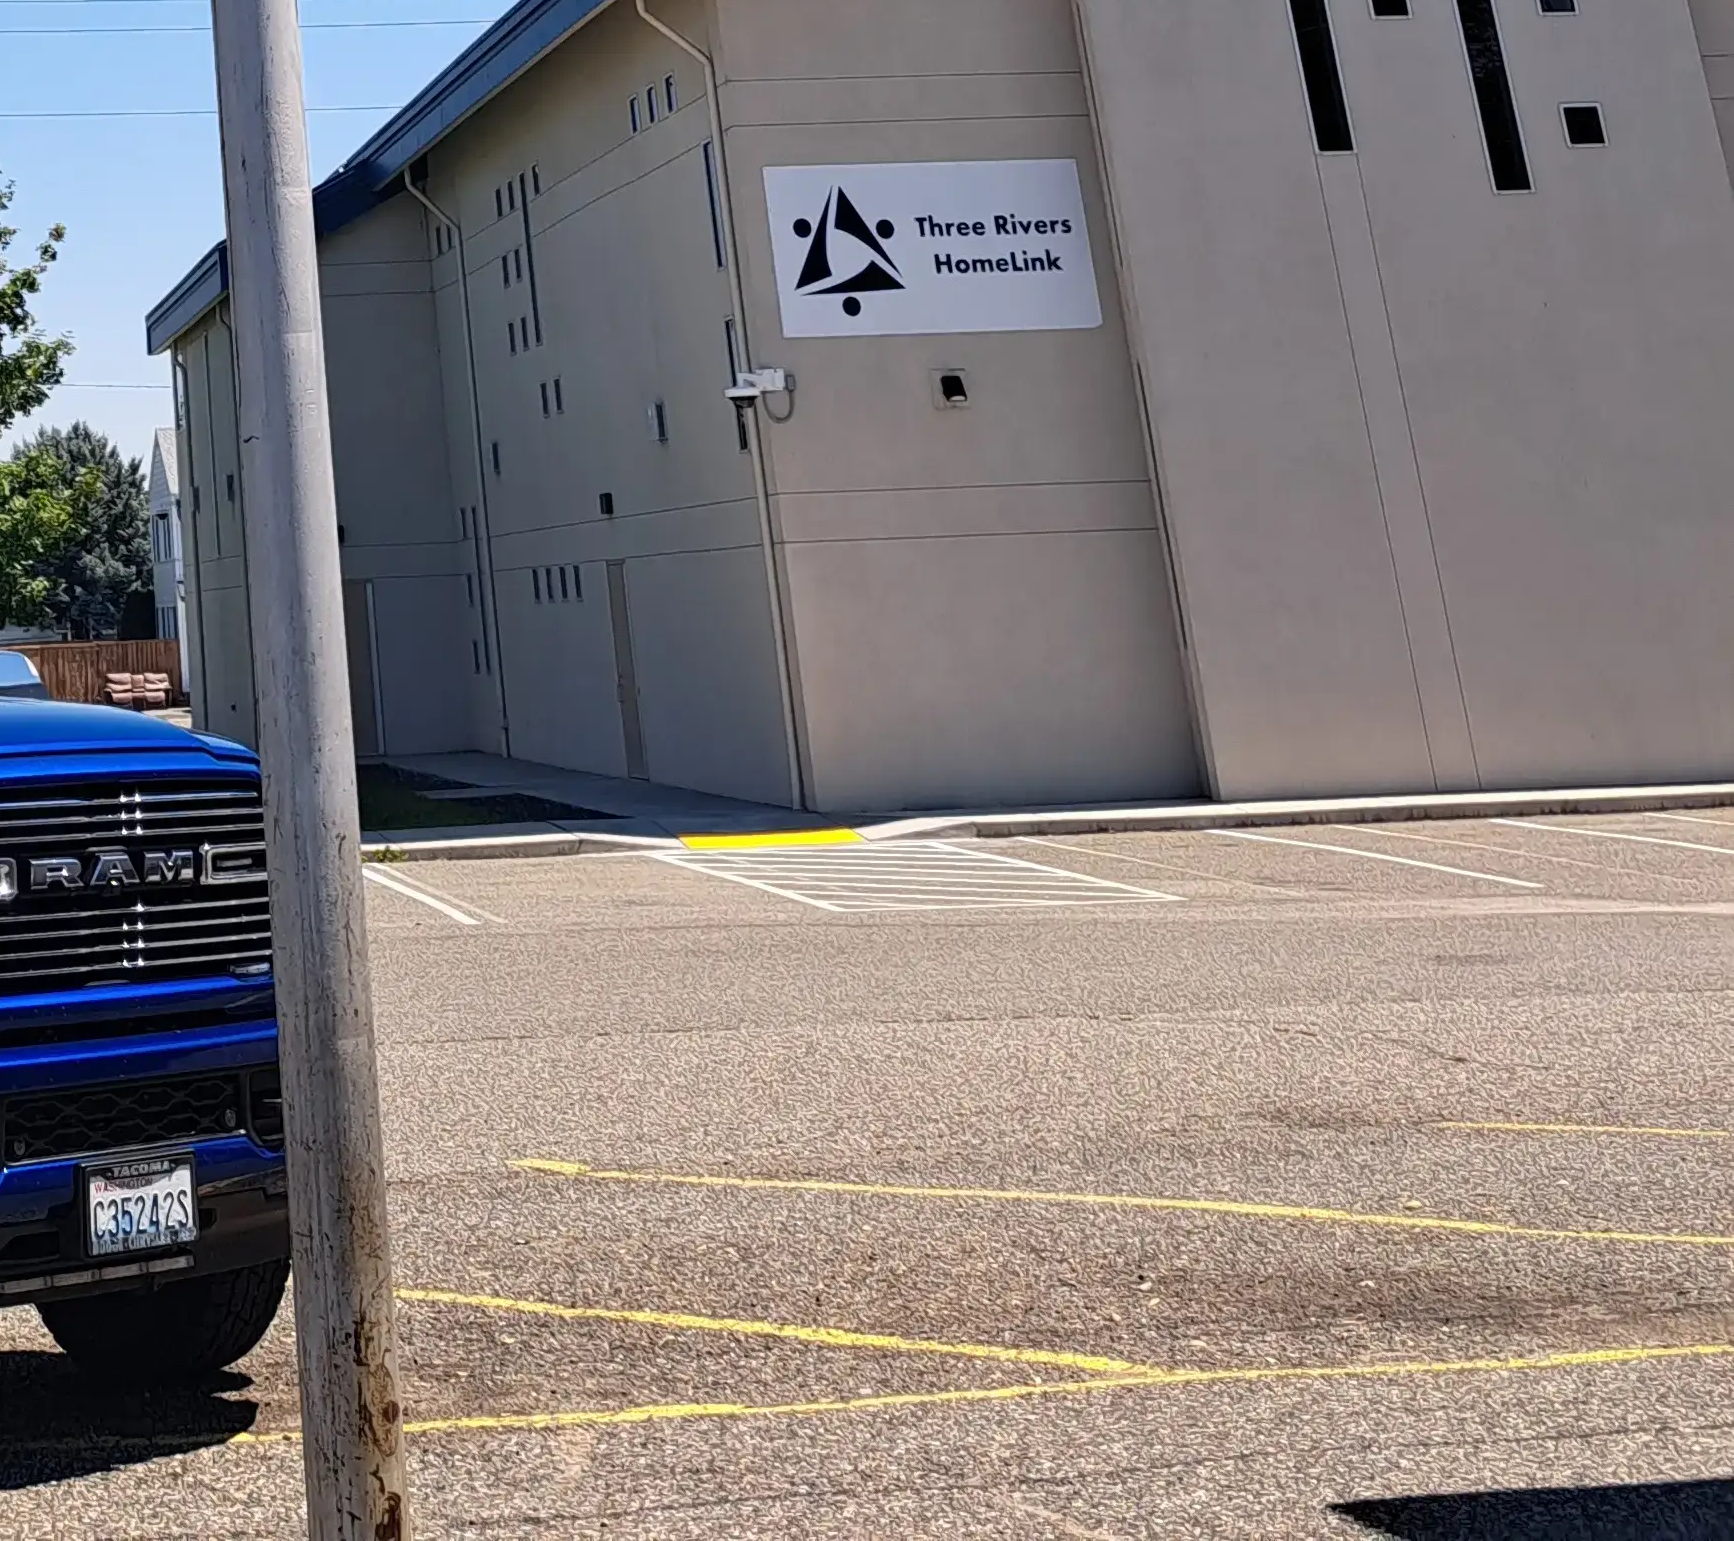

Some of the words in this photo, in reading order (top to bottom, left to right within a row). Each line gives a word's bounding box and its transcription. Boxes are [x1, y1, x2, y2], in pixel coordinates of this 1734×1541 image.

[914, 215, 986, 238] Three
[994, 214, 1072, 236] Rivers
[933, 249, 1065, 274] HomeLink
[29, 850, 194, 891] RAM
[112, 1160, 171, 1178] TACOMA
[94, 1177, 154, 1194] WASHINGTON
